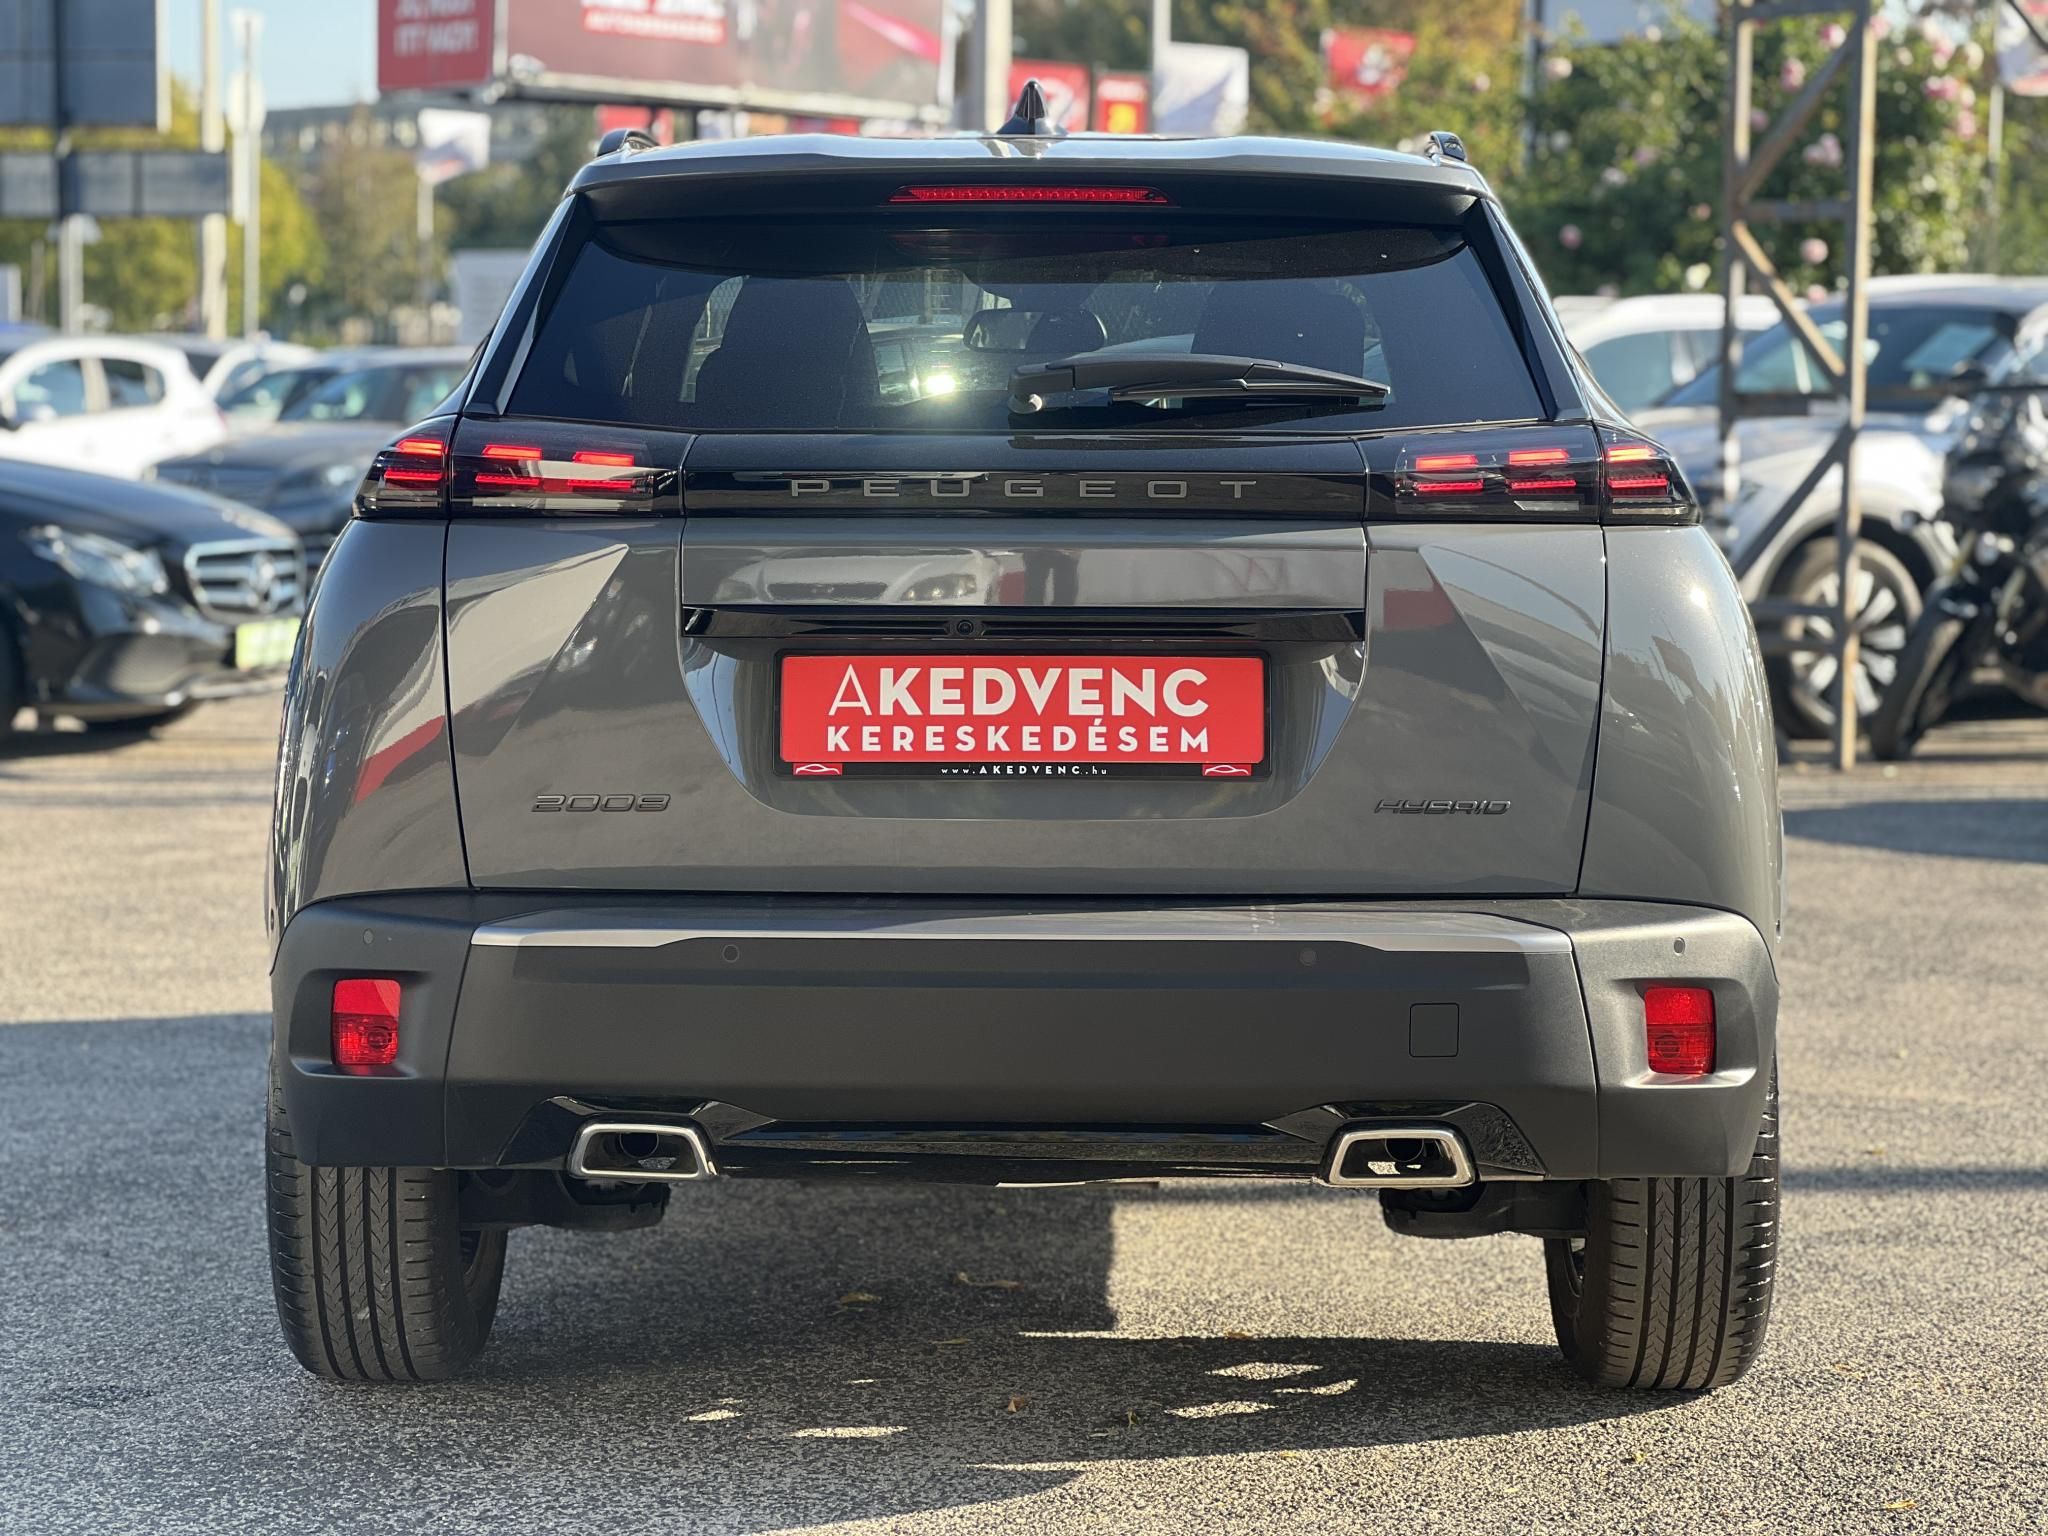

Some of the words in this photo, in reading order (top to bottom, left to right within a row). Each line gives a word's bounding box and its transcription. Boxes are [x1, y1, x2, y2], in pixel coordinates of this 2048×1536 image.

[790, 478, 1258, 499] PEUGEOT
[826, 718, 1210, 754] KERESKEDÉSEM
[531, 793, 671, 813] 2008
[1374, 798, 1511, 815] HYBRID
